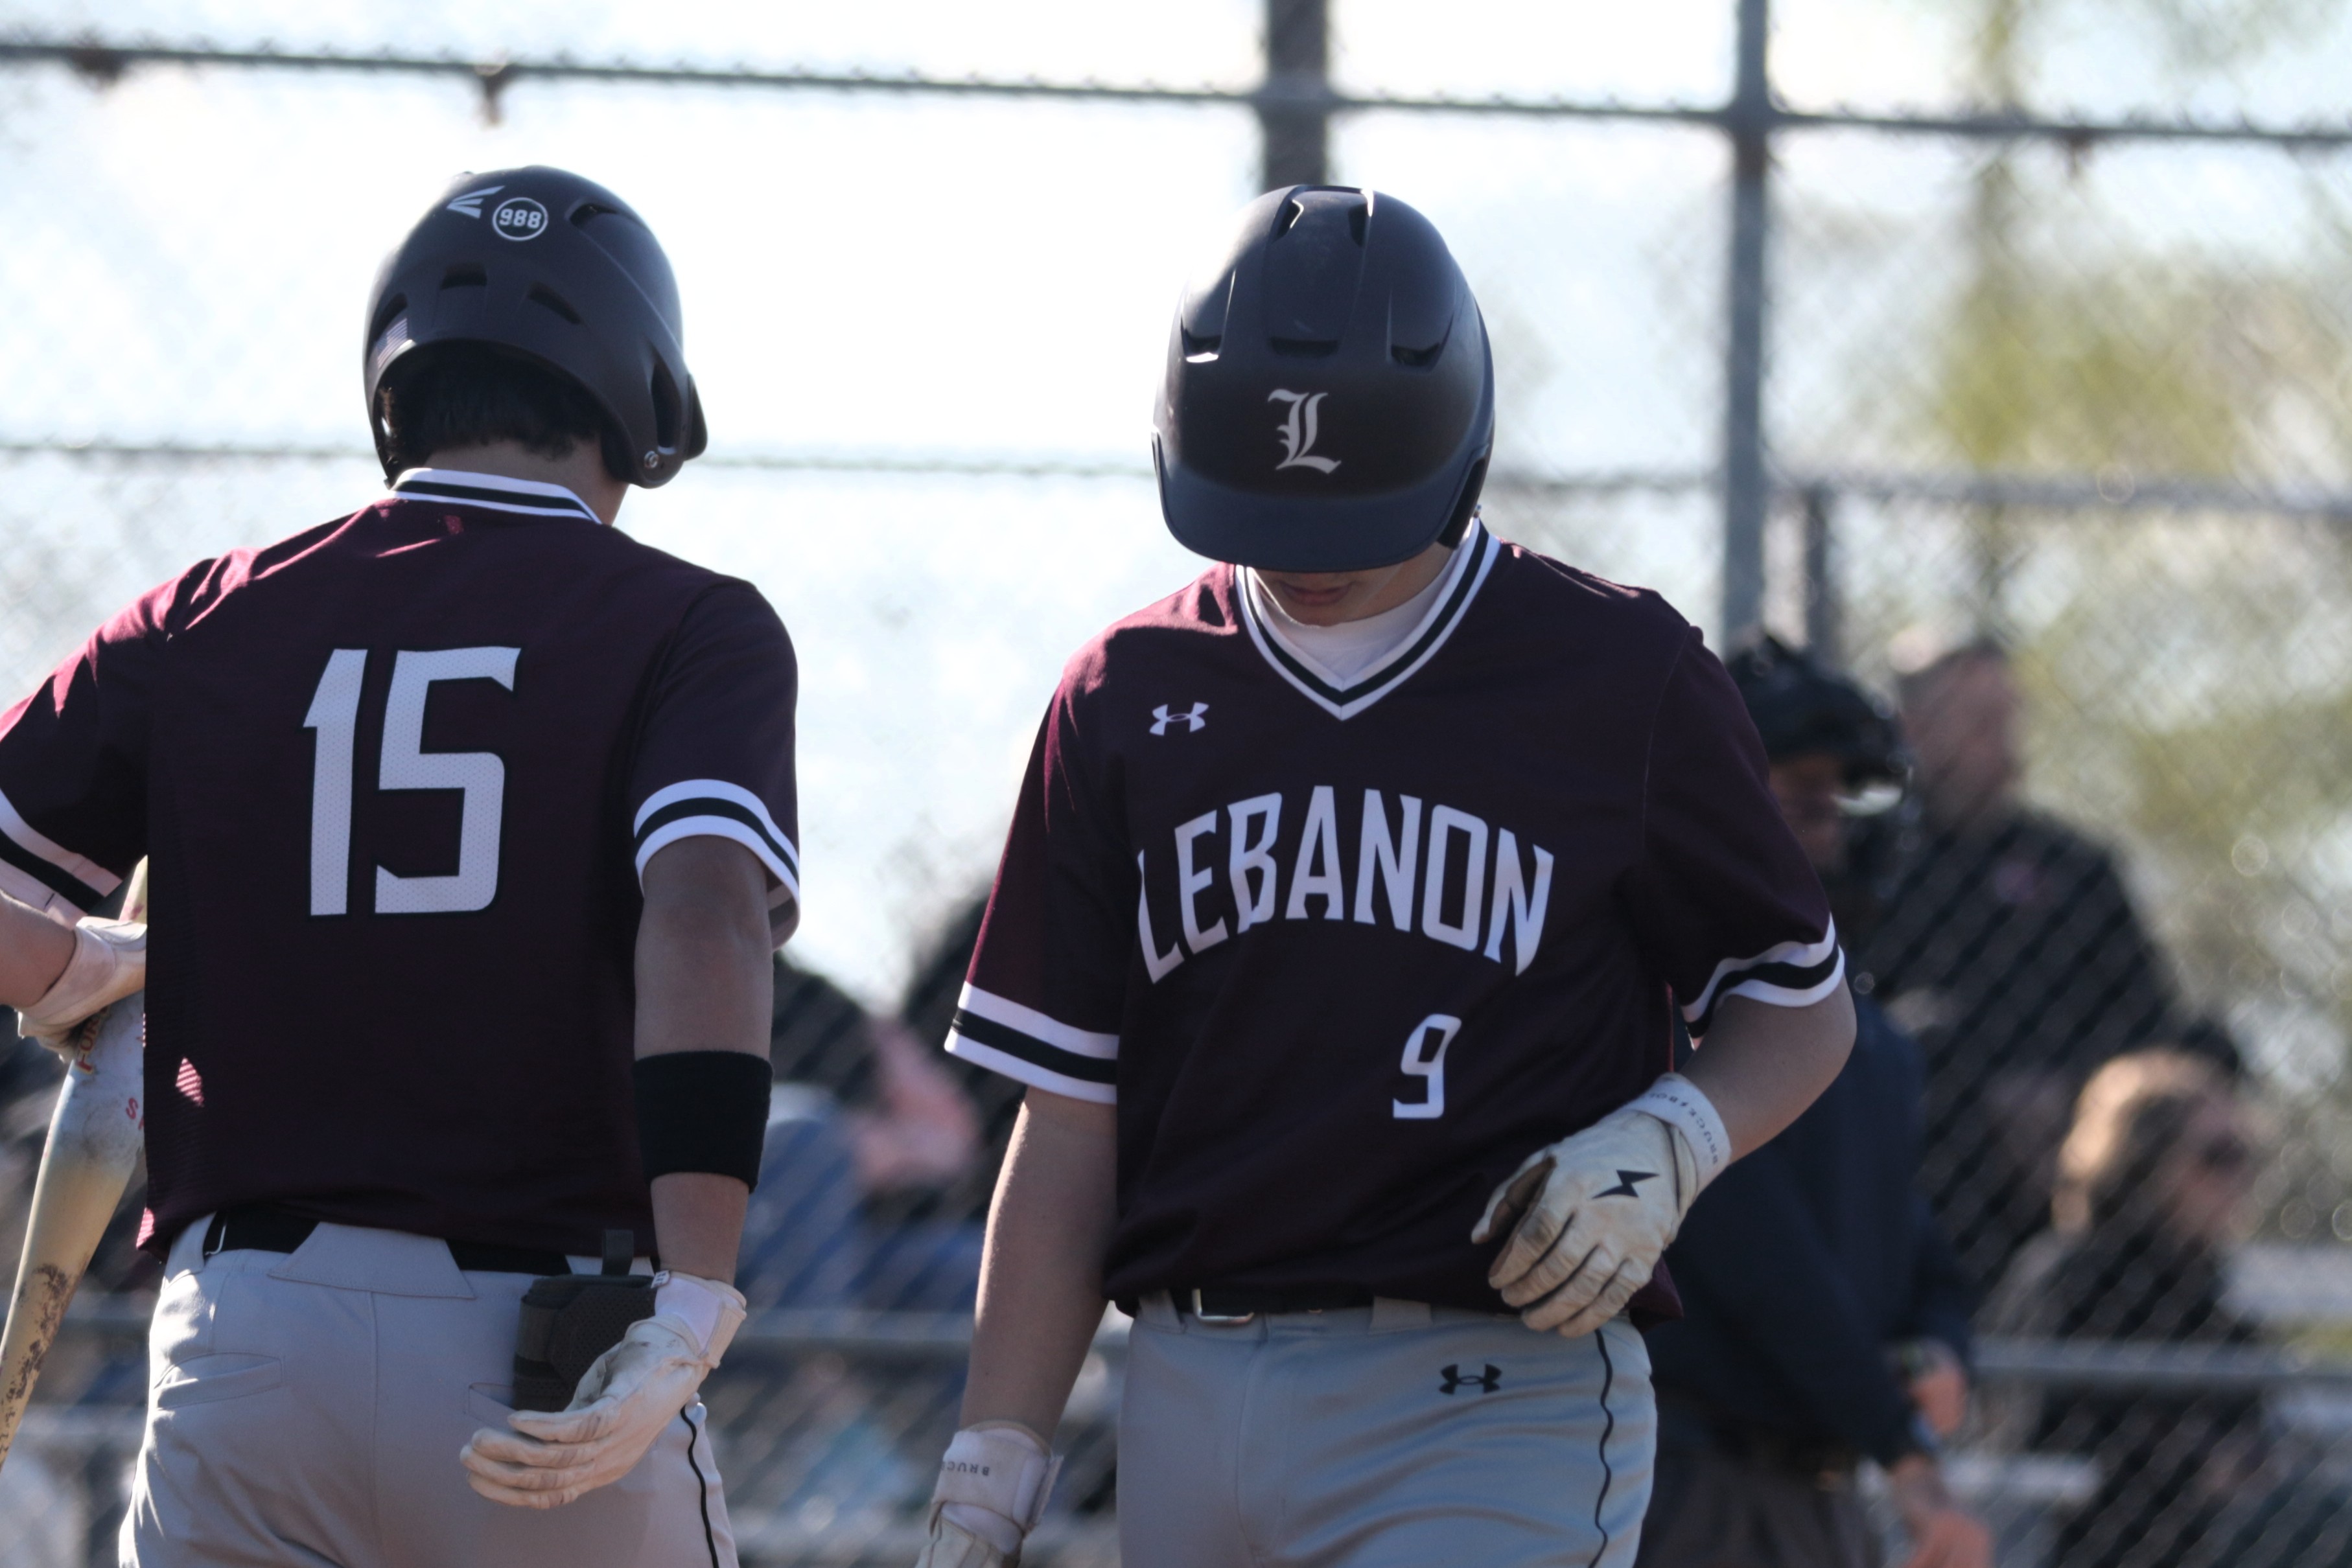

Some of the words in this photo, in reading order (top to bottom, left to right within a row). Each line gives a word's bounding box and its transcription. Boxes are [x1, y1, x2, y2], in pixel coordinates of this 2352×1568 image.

[498, 208, 542, 229] 988
[1268, 389, 1342, 474] L
[303, 646, 521, 916] 15
[1137, 785, 1554, 985] LEBANON
[1393, 1014, 1461, 1119] 9
